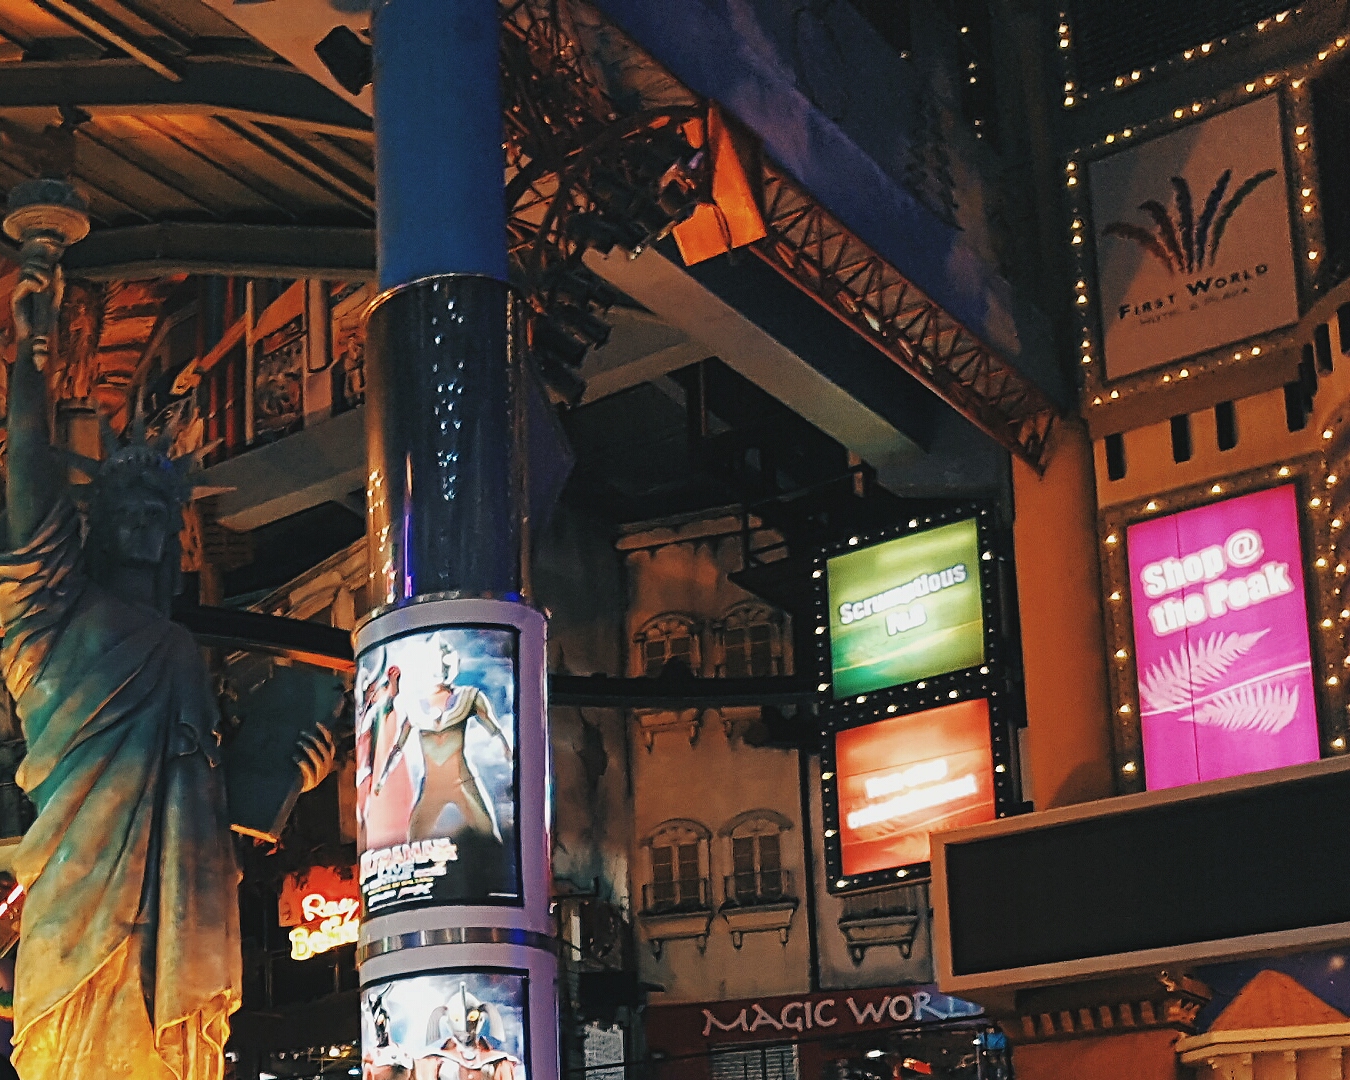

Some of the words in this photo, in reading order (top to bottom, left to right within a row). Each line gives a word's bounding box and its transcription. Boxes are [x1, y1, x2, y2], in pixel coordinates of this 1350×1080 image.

[1141, 546, 1226, 597] Shop
[1225, 530, 1263, 567] @
[1150, 595, 1207, 635] the
[1206, 563, 1292, 617] Peak
[701, 1000, 838, 1037] MAGIC
